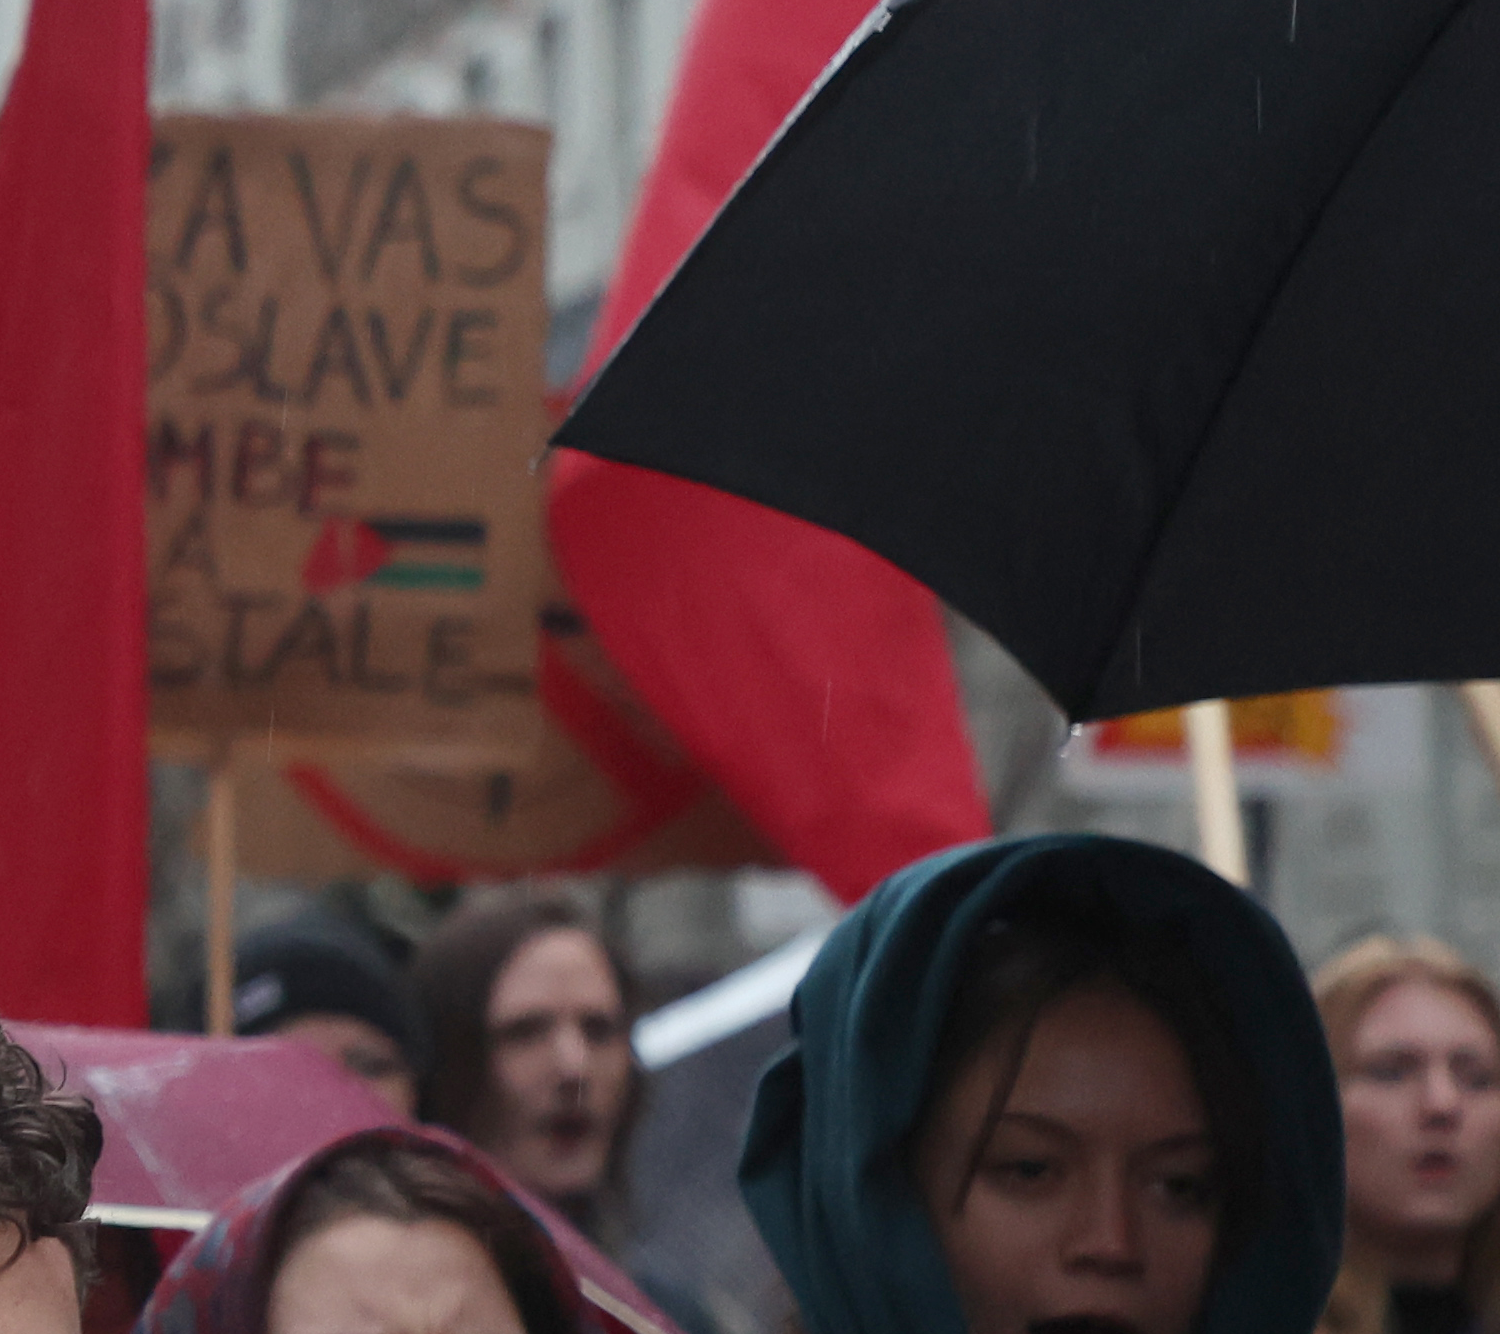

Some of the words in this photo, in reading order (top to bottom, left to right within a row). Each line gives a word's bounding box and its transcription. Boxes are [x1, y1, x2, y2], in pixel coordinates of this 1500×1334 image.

[150, 139, 248, 275] A
[287, 149, 530, 289] VAS
[148, 415, 360, 515] MBE
[150, 589, 478, 709] STALE
